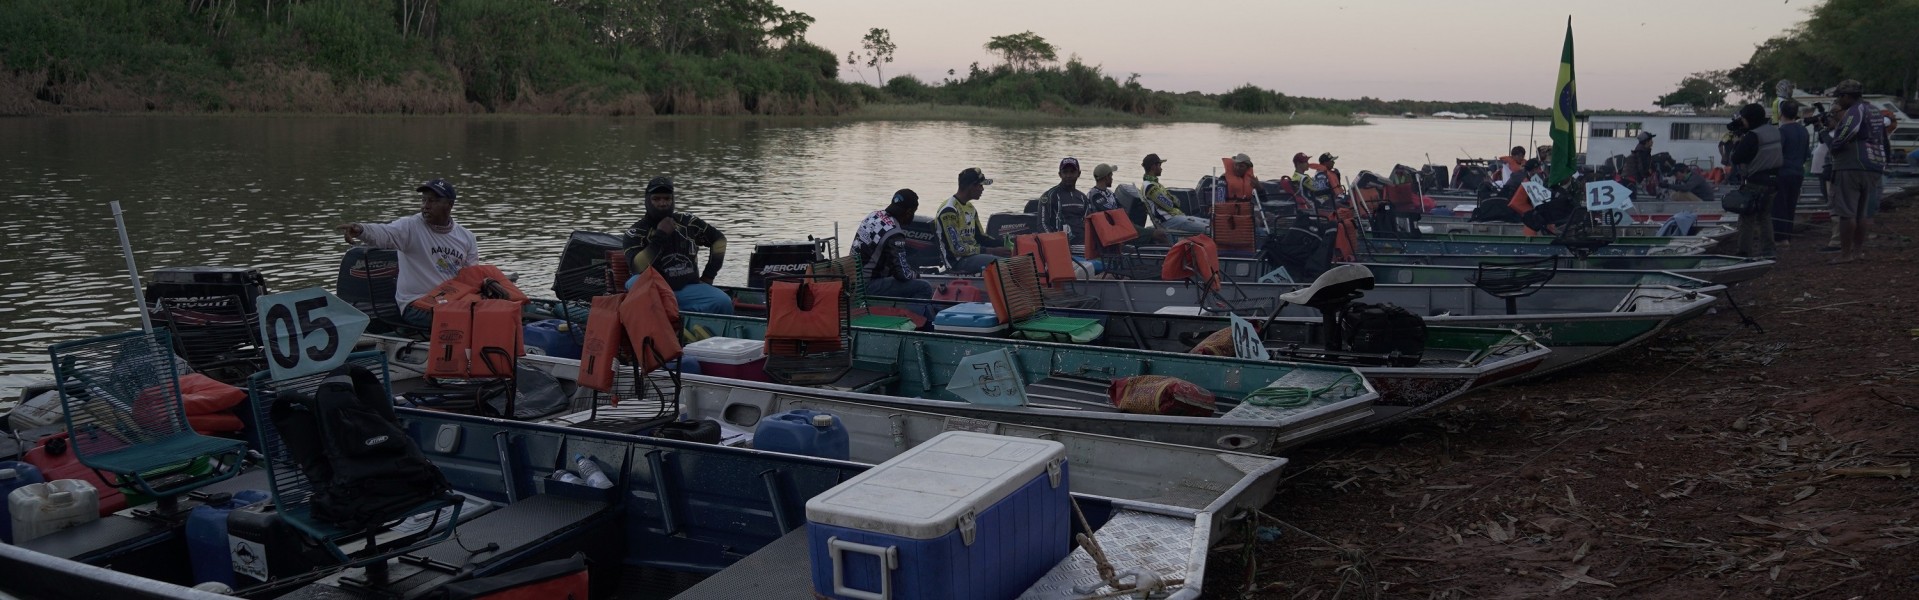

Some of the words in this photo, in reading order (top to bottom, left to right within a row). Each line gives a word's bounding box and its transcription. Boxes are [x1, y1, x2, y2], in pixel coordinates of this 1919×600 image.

[1589, 186, 1615, 206] 13
[760, 263, 809, 275] MERCUR
[266, 296, 338, 369] 05
